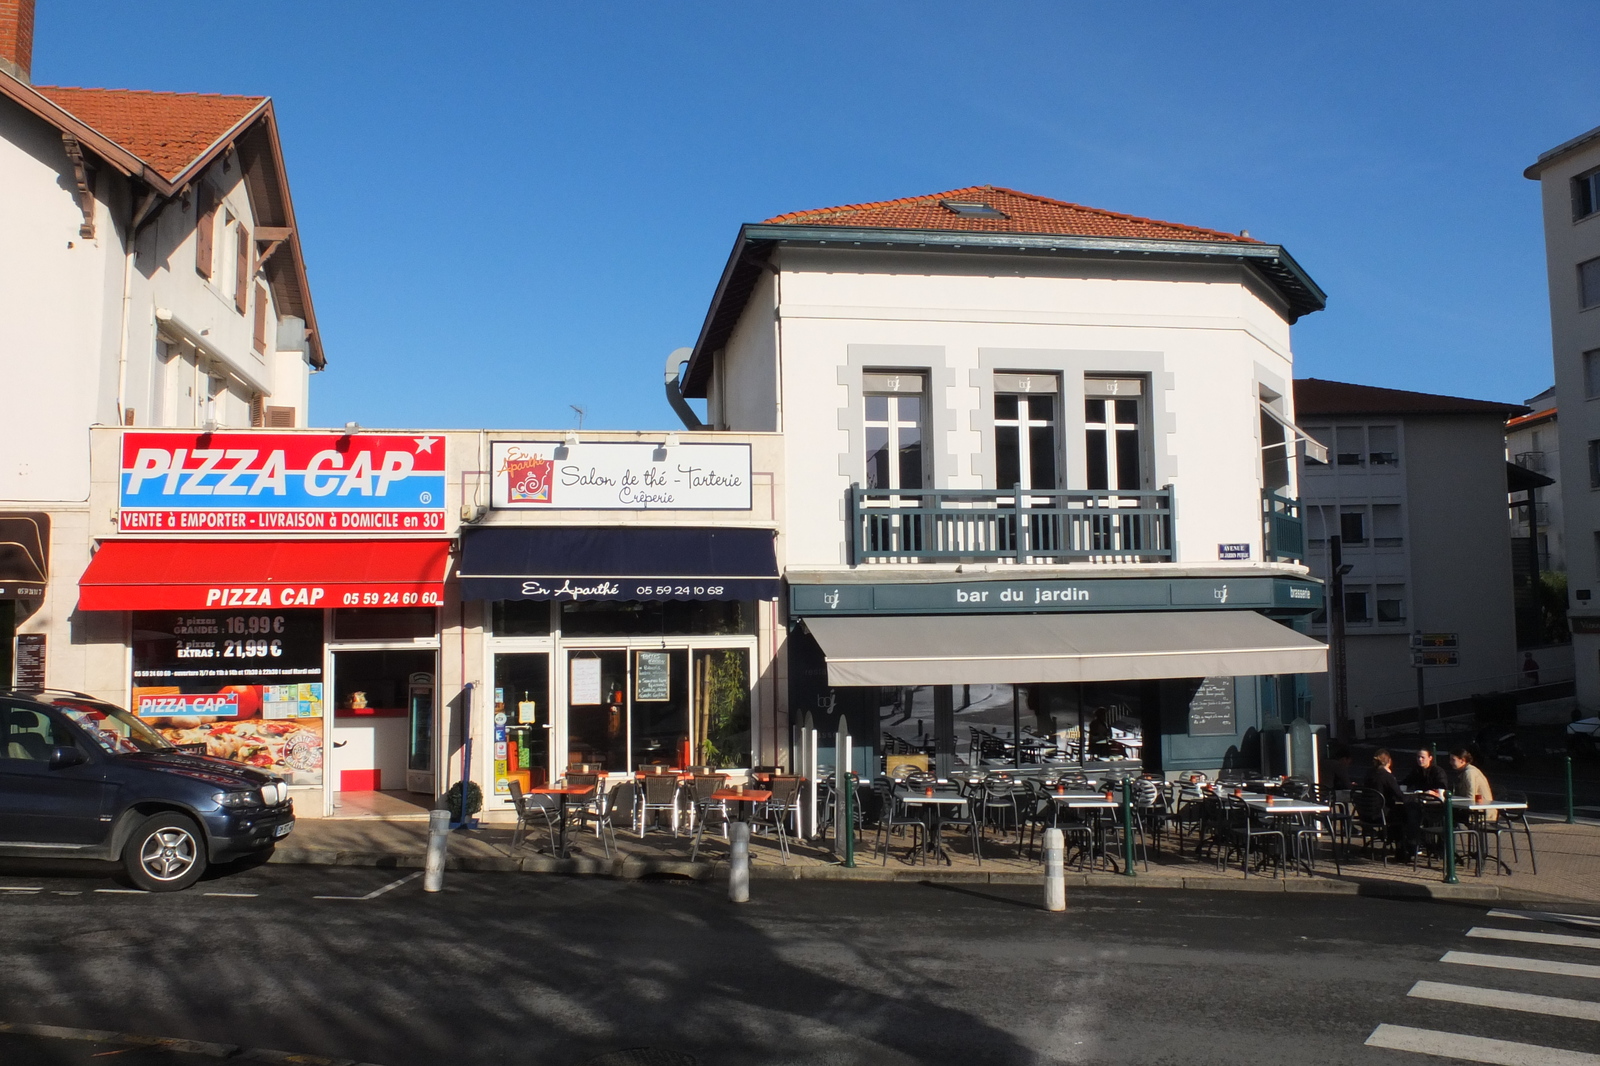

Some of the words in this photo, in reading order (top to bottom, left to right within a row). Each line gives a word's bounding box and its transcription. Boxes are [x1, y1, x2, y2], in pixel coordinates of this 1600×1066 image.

[507, 447, 528, 460] En
[126, 448, 286, 496] PIZZA
[303, 450, 414, 497] CAP
[561, 466, 616, 487] Salon
[622, 468, 639, 487] de
[644, 470, 667, 487] thé
[678, 464, 742, 489] Tarterie
[619, 486, 674, 508] Crêperie
[123, 512, 162, 527] VENTE
[168, 511, 175, 527] à
[180, 513, 246, 528] EMPORTER
[259, 513, 324, 528] LIVRAISON
[330, 511, 337, 528] à
[342, 513, 398, 528] DOMICILE
[404, 517, 418, 528] en
[206, 588, 271, 606] PIZZA
[280, 588, 324, 606] CAP
[343, 592, 360, 605] 05
[363, 592, 379, 604] 59
[383, 592, 400, 604] 24
[403, 592, 419, 604] 60
[422, 592, 437, 604] 60
[521, 582, 550, 595] En
[554, 580, 619, 599] Aparthé
[636, 586, 653, 595] 05
[656, 586, 671, 595] 59
[674, 586, 690, 595] 24
[694, 586, 705, 595] 10
[707, 586, 724, 595] 68
[956, 588, 988, 603] bar
[1000, 588, 1024, 602] du
[1034, 587, 1089, 604] jardin
[174, 626, 218, 634] GRANDES
[186, 617, 216, 626] pizzas
[226, 616, 270, 635] 16,99
[273, 616, 285, 633] €
[176, 640, 183, 648] 2
[186, 640, 215, 649] pizzas
[224, 639, 268, 658] 21,99
[270, 639, 282, 657] €
[177, 649, 214, 658] EXTRAS
[141, 698, 186, 713] PIZZA
[192, 698, 226, 712] CAP
